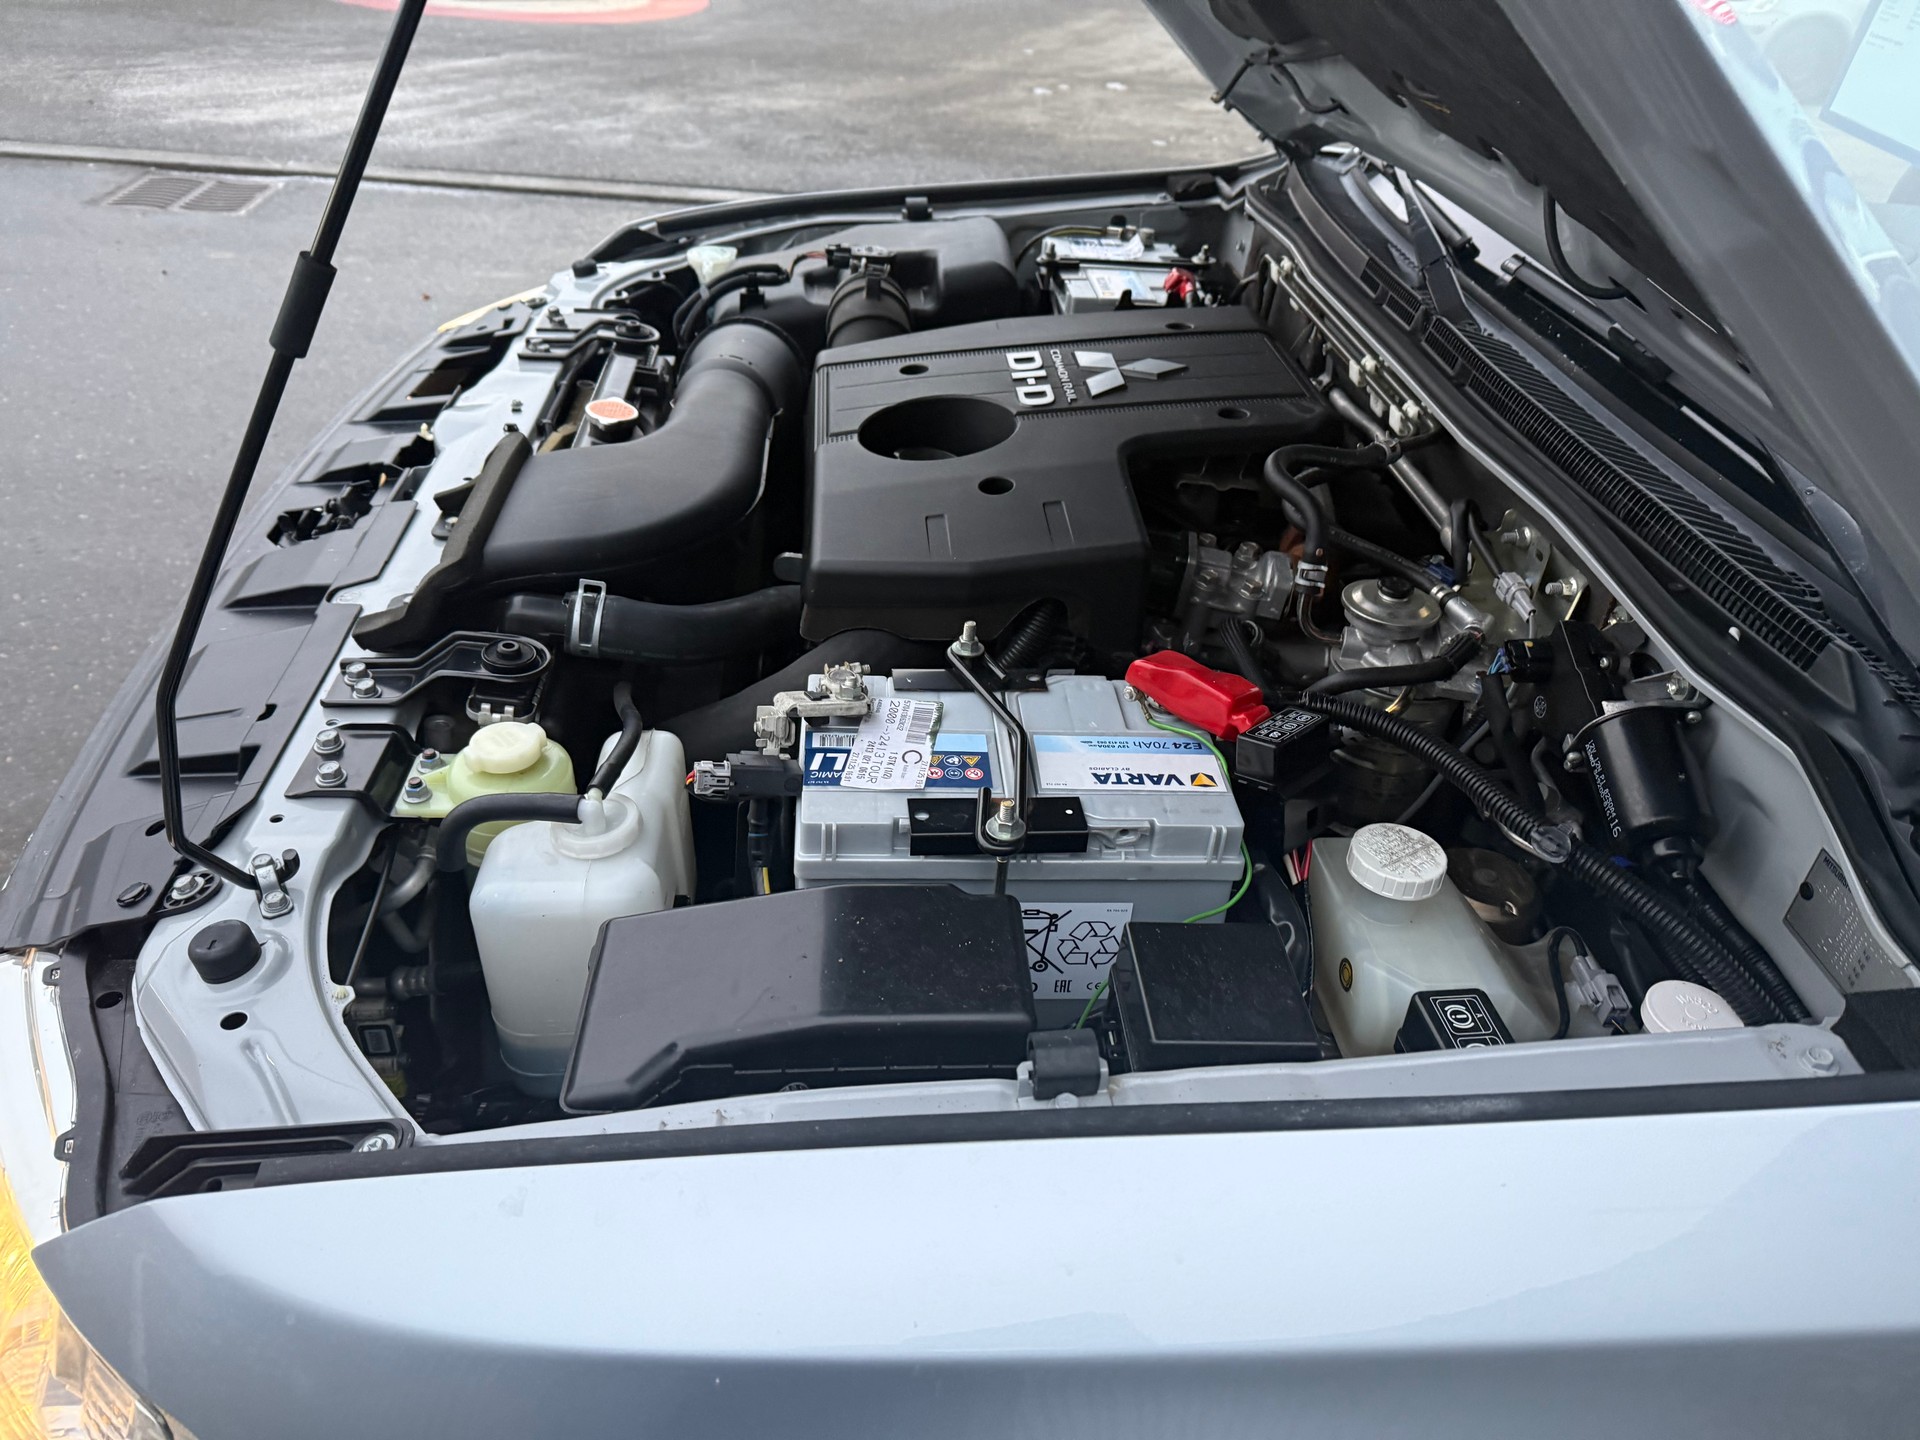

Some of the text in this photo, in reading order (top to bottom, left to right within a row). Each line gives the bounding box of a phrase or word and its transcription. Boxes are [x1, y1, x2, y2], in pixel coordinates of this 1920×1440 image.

[1005, 350, 1056, 406] DI-D
[1050, 349, 1078, 403] COMMON RAIL
[885, 700, 900, 725] 2000
[1133, 741, 1169, 750] 70Ah
[1172, 741, 1203, 750] E24
[809, 752, 848, 771] LI
[901, 749, 923, 765] C
[810, 771, 843, 779] AMIC
[865, 760, 884, 784] TOUR
[1090, 772, 1186, 786] VARTA
[1054, 980, 1072, 992] EAC
